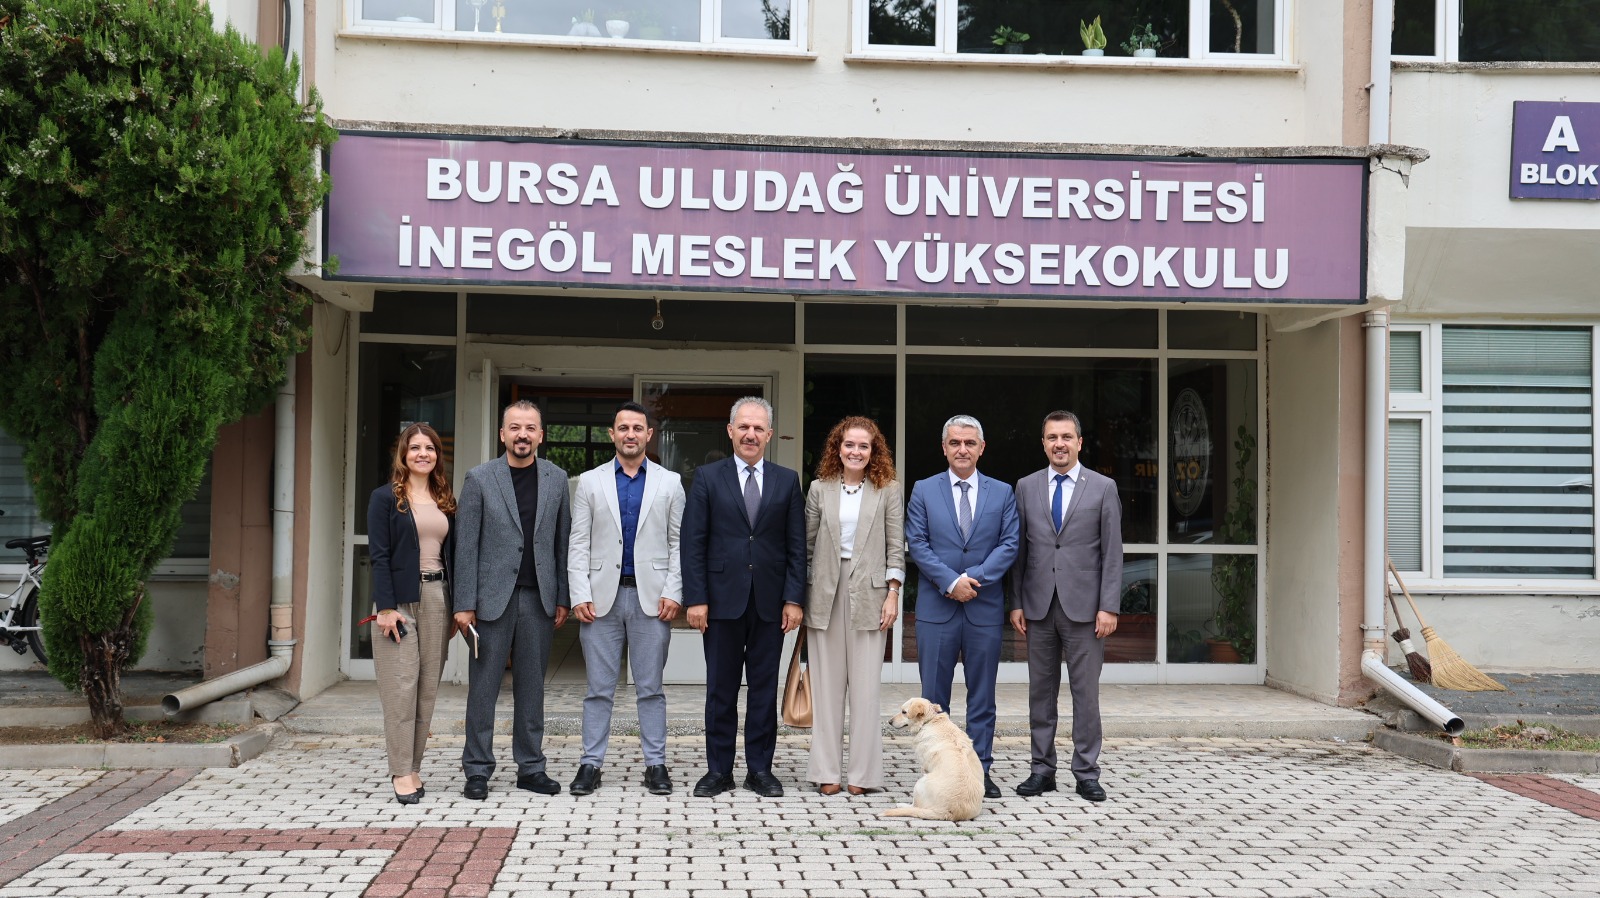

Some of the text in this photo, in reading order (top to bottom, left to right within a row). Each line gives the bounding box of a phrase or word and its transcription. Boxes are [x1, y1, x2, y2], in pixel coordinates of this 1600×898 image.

[1542, 115, 1580, 152] A
[426, 157, 1265, 223] BURSA ULUDAĞ ÜNİVERSİTESİ
[1520, 163, 1599, 186] BLOK
[398, 215, 1289, 289] İNEGÖL MESLEK YÜKSEKOKULU
